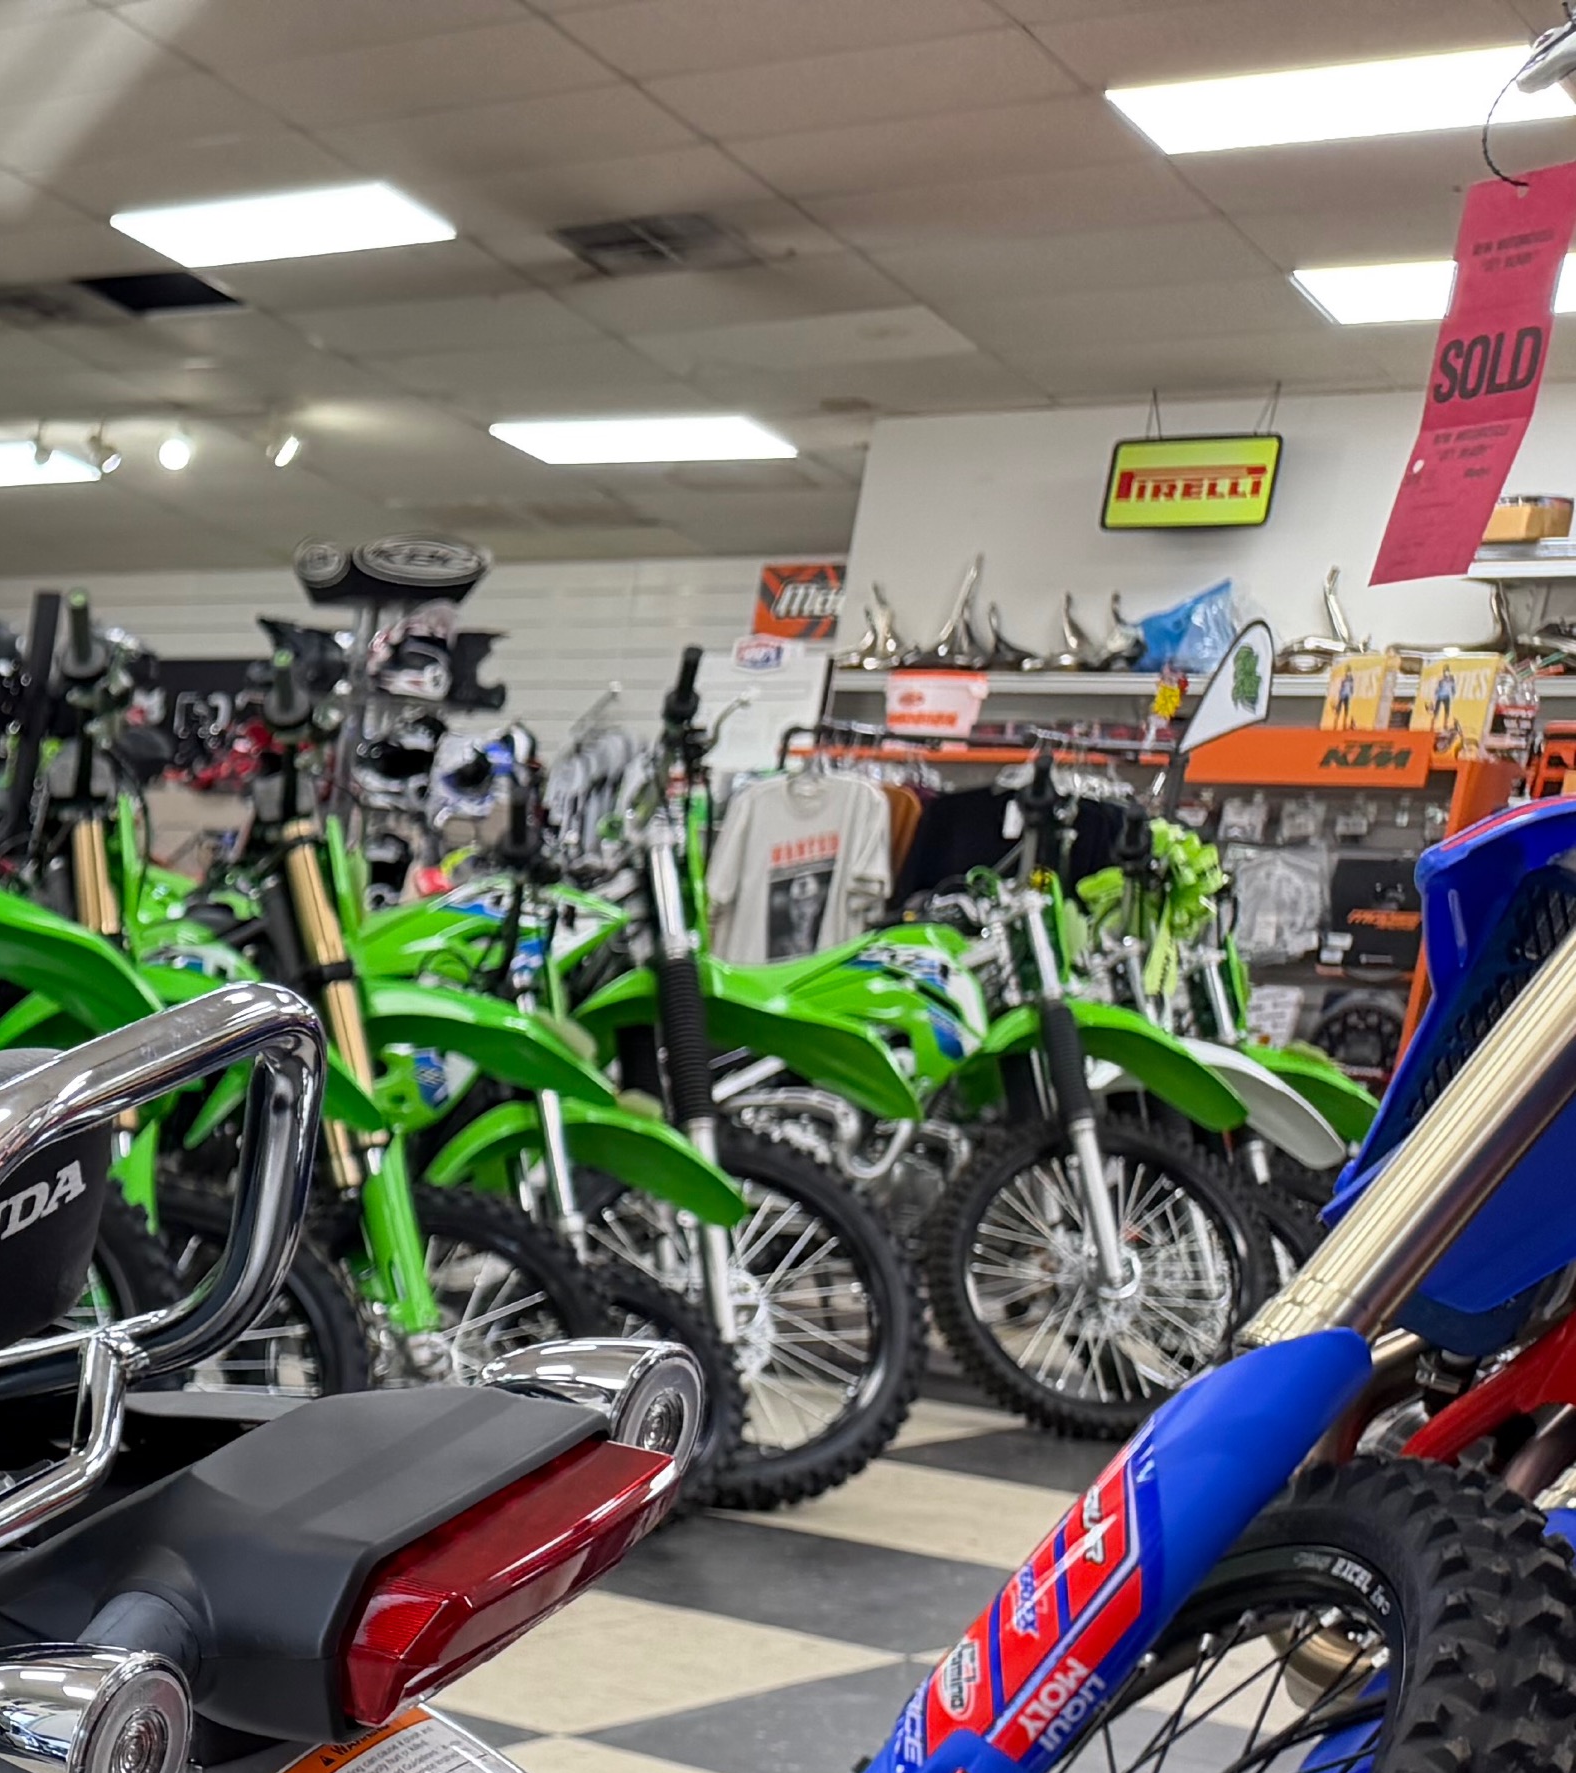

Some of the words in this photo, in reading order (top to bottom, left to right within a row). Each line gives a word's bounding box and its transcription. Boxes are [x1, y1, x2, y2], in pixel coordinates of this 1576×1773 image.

[1433, 326, 1542, 404] SOLD
[1116, 465, 1267, 502] PIRELLI
[1320, 742, 1413, 769] KTM
[1018, 1657, 1089, 1742] MOLY
[1039, 1672, 1106, 1753] LIQUI
[362, 1756, 378, 1769] can
